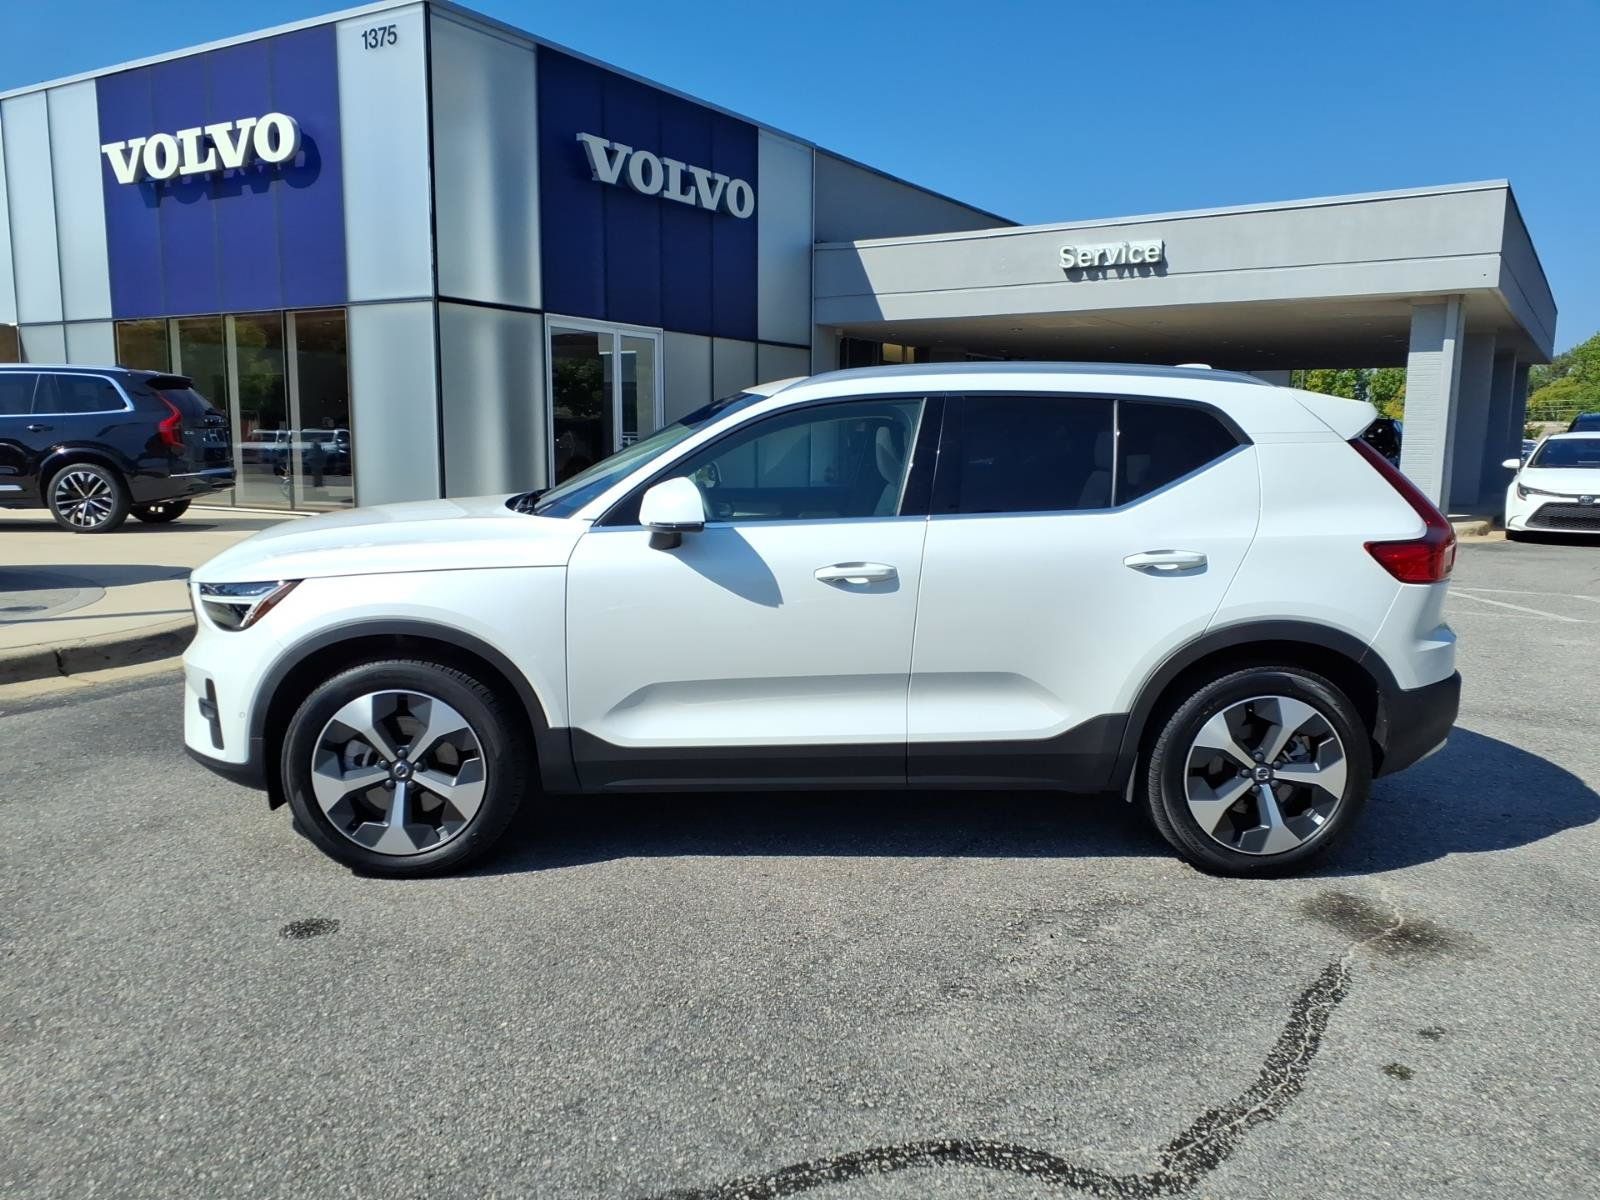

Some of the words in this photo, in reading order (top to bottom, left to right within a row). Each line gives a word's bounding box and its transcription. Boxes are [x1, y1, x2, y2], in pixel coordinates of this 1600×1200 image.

[361, 24, 397, 50] 1375
[101, 112, 299, 185] VOLVO
[576, 132, 755, 219] VOLVO
[1059, 241, 1162, 268] Service
